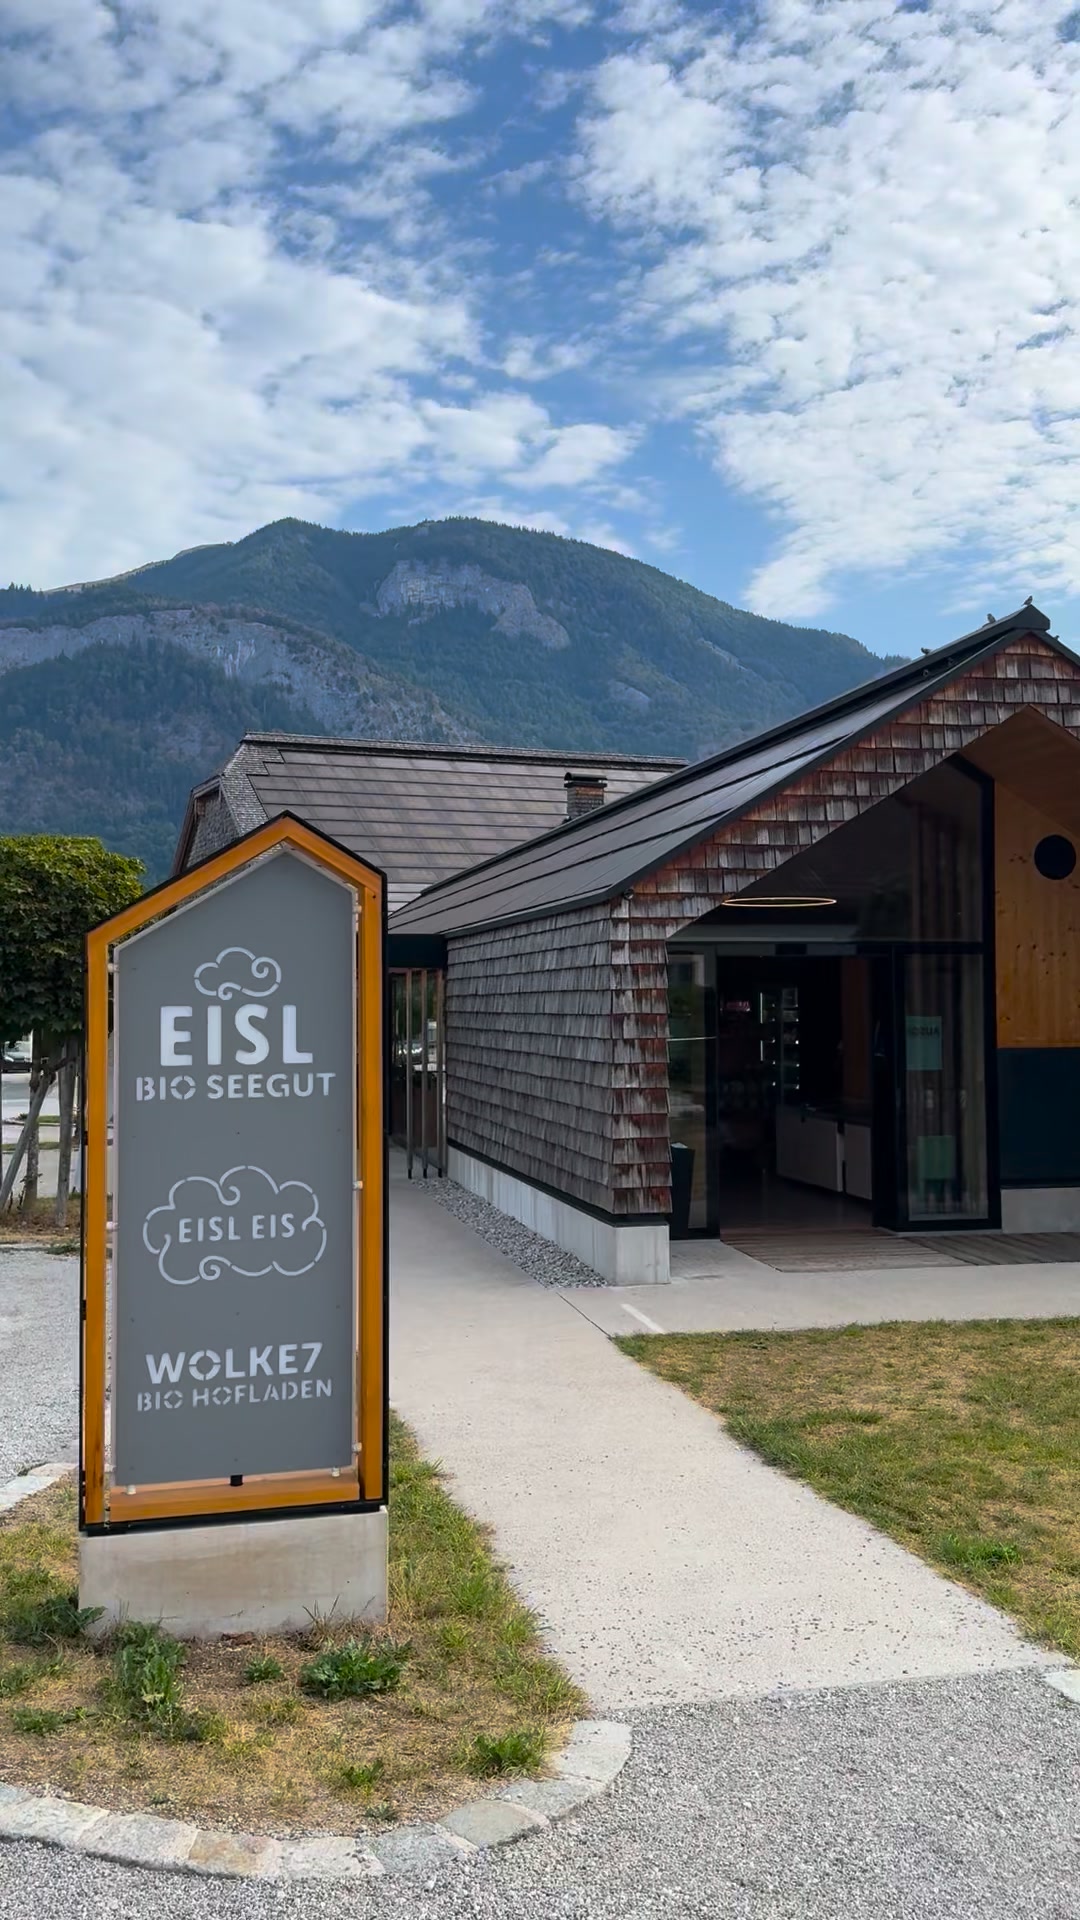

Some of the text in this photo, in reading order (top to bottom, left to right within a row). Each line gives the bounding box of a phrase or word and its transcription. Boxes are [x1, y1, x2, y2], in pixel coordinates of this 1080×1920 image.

[160, 1003, 314, 1067] EISL
[135, 1072, 336, 1101] BIO SEEGUT
[178, 1213, 296, 1243] EISL EIS
[145, 1342, 323, 1385] WOLKE7
[136, 1379, 333, 1411] BIO HOFLADEN
